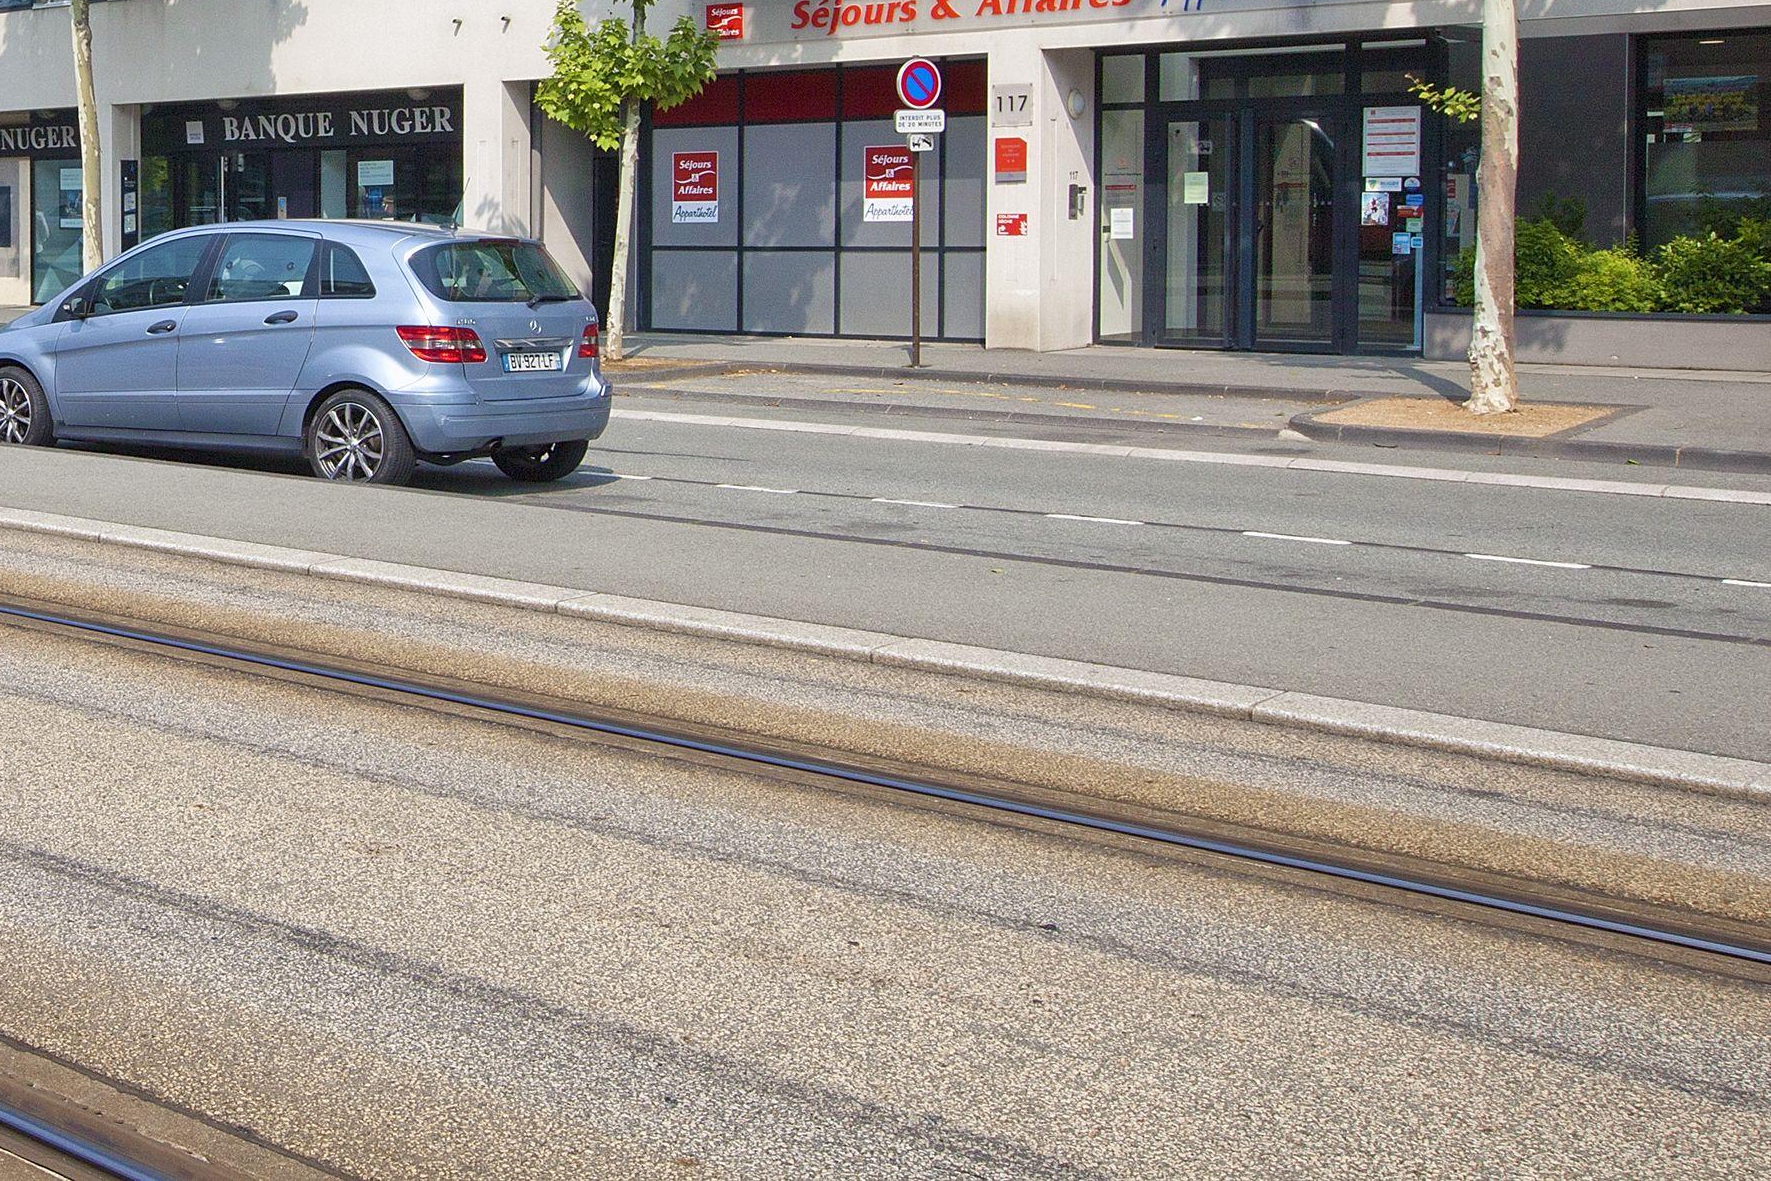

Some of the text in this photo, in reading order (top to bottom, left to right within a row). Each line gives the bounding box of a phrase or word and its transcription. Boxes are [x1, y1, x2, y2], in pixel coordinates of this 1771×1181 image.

[997, 95, 1028, 113] 117
[223, 106, 455, 143] BANQUE NUGER
[1, 125, 77, 151] NUGER
[679, 160, 712, 171] Séjours
[871, 155, 909, 166] Séjours
[678, 186, 714, 194] Affaires
[870, 181, 911, 192] Affaires
[674, 205, 718, 222] Apparthotel
